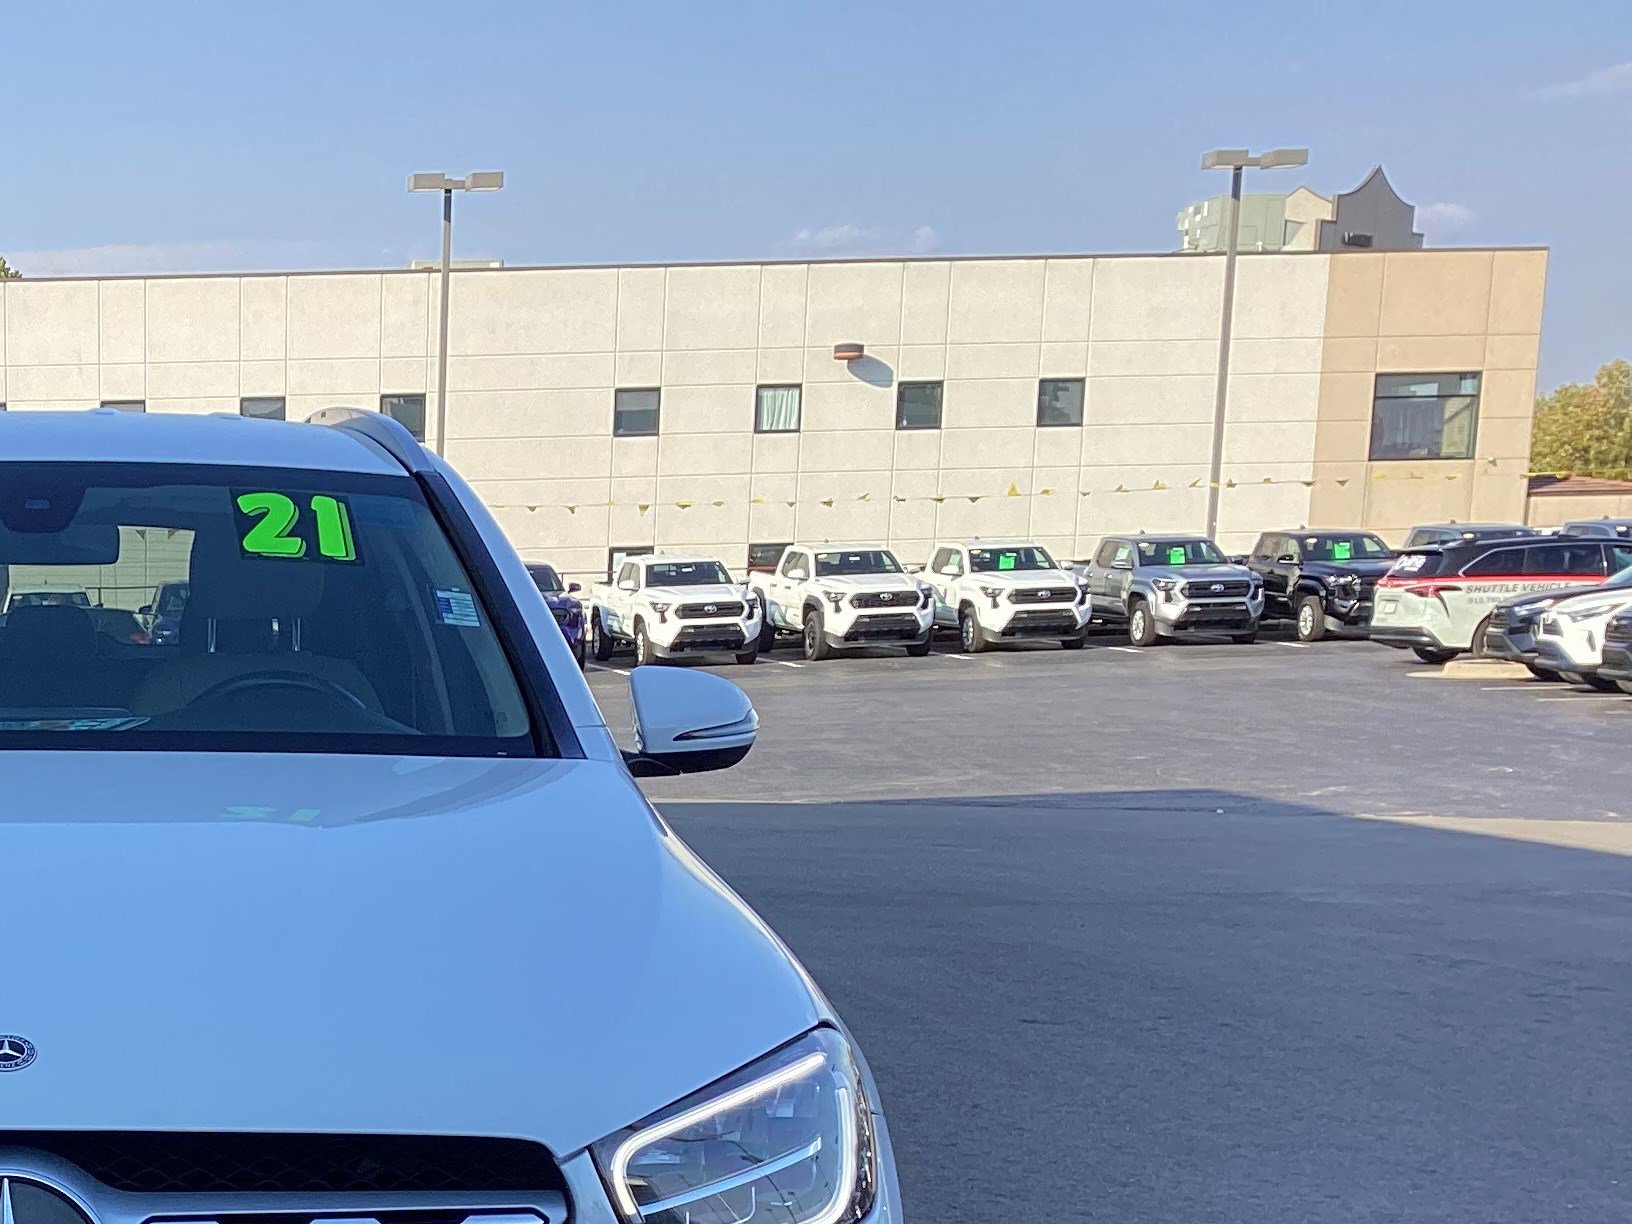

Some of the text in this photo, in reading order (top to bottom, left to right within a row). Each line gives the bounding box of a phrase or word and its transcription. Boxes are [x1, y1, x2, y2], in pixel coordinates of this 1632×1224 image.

[236, 491, 357, 561] 21
[1465, 582, 1571, 594] SHUTTLE VEHICLE
